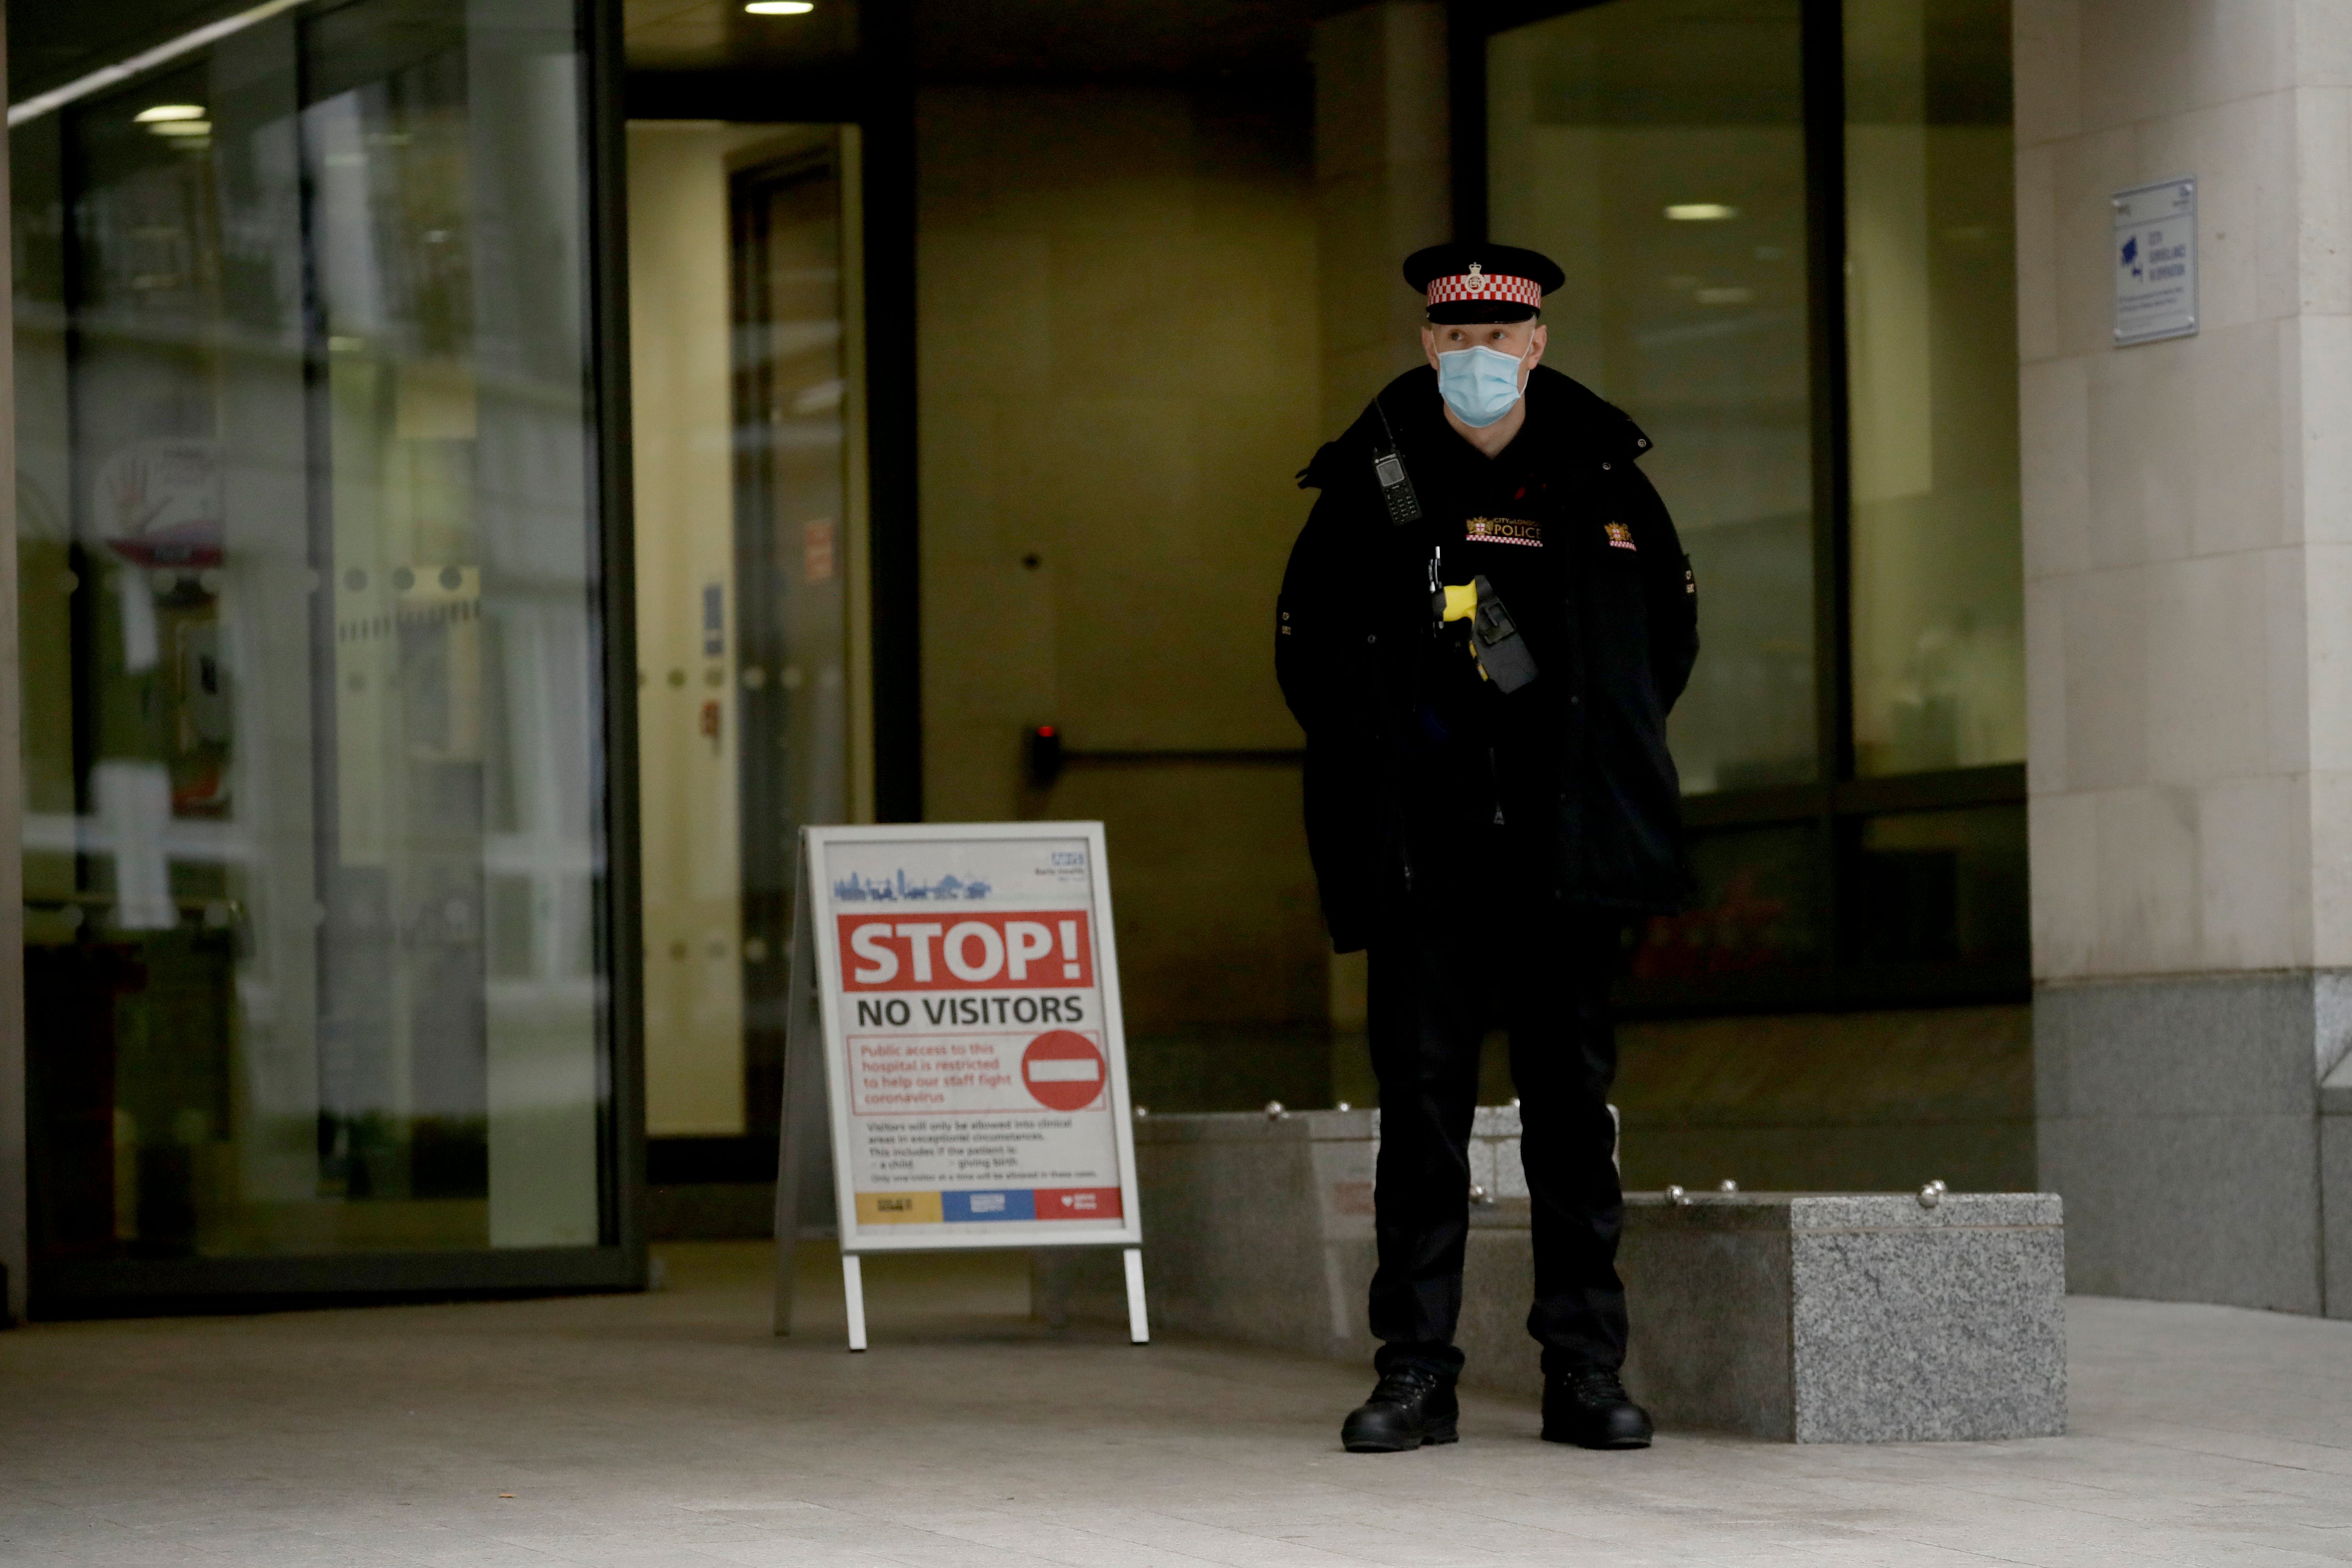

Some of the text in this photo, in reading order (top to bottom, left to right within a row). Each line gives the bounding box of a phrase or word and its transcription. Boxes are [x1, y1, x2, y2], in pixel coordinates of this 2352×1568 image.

[1494, 524, 1542, 539] POLICE
[850, 919, 1082, 984] STOP!
[858, 995, 1083, 1027] NO VISITORS
[861, 1043, 995, 1057] Public access to this
[862, 1058, 999, 1072] hospital is restricted
[863, 1074, 1011, 1089] to help our staff fight
[865, 1092, 944, 1103] coronavirus
[867, 1118, 1072, 1132] Visitors will only be allowed into clinical
[910, 1134, 968, 1144] exceptional
[870, 1148, 890, 1157] This
[893, 1147, 934, 1157] includes
[937, 1147, 945, 1155] if
[947, 1147, 963, 1155] the
[967, 1146, 1004, 1156] patient
[888, 1160, 914, 1170] child
[958, 1158, 1017, 1170] giving birth
[871, 1175, 891, 1184] Only
[1006, 1171, 1037, 1179] allowed
